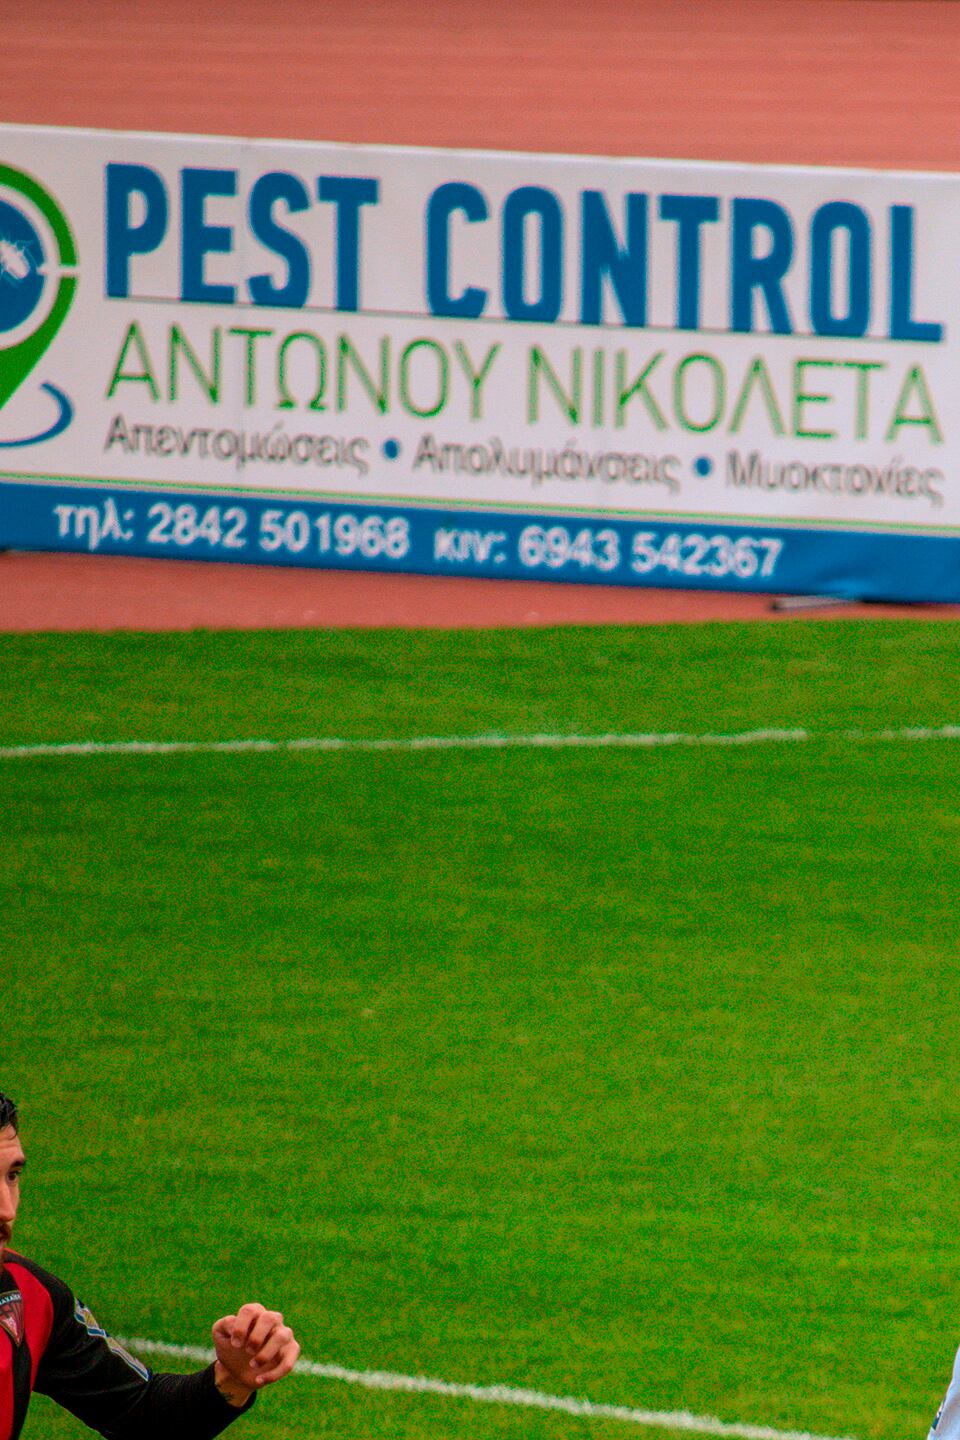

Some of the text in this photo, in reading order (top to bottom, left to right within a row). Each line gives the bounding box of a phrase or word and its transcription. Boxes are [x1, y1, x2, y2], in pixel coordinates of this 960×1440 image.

[105, 163, 944, 342] PEST CONTROL
[107, 319, 944, 444] ΑΝΤΩΝΟΥ ΝΙΚΟΛΕΤΑ
[104, 413, 946, 507] Απεντομώσεις Απολυμάνσεις Μυοκτονίες
[54, 498, 134, 550] τηλ:
[147, 502, 247, 548] 2842
[259, 509, 410, 560] 501968
[518, 525, 620, 572] 6943
[631, 530, 783, 578] 542367
